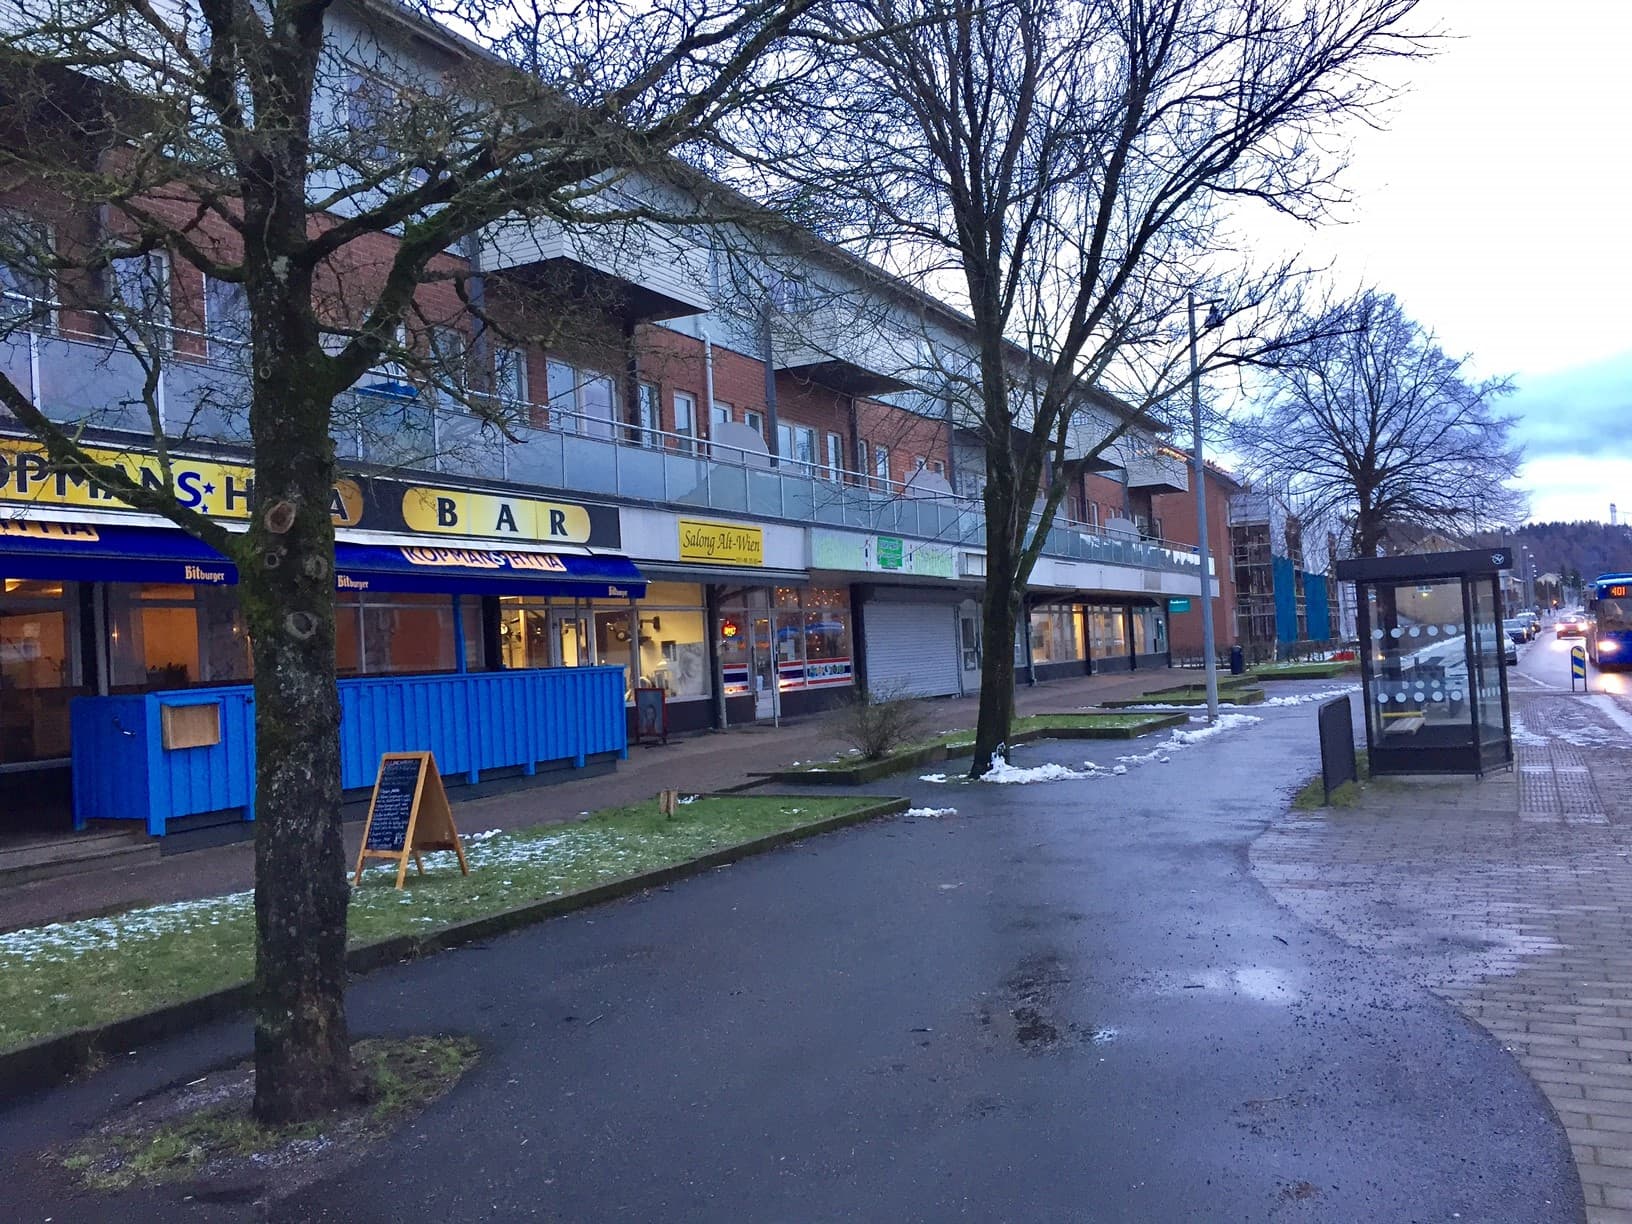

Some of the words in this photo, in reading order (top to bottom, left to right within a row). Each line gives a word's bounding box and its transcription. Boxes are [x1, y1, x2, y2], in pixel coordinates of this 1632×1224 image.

[436, 496, 569, 537] BAR
[682, 528, 716, 556] Salong
[717, 532, 760, 553] Alt-Wien
[184, 565, 225, 583] Bitburger
[337, 574, 369, 591] Bitburger
[1611, 586, 1626, 596] 401
